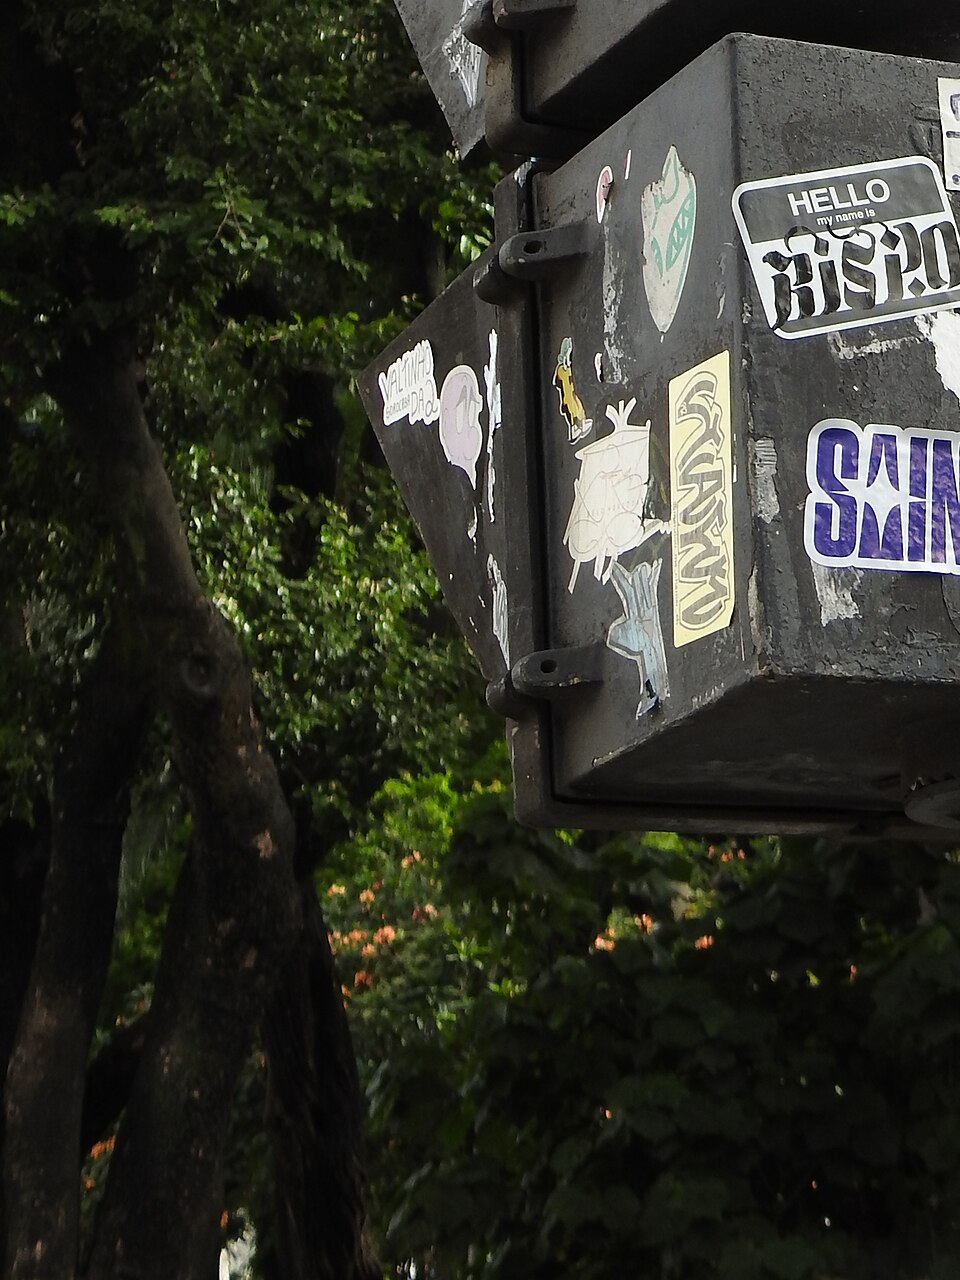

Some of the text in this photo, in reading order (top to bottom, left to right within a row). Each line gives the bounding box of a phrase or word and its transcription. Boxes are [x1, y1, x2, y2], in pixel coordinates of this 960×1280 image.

[788, 179, 890, 216] HELLO
[816, 207, 876, 227] my name is
